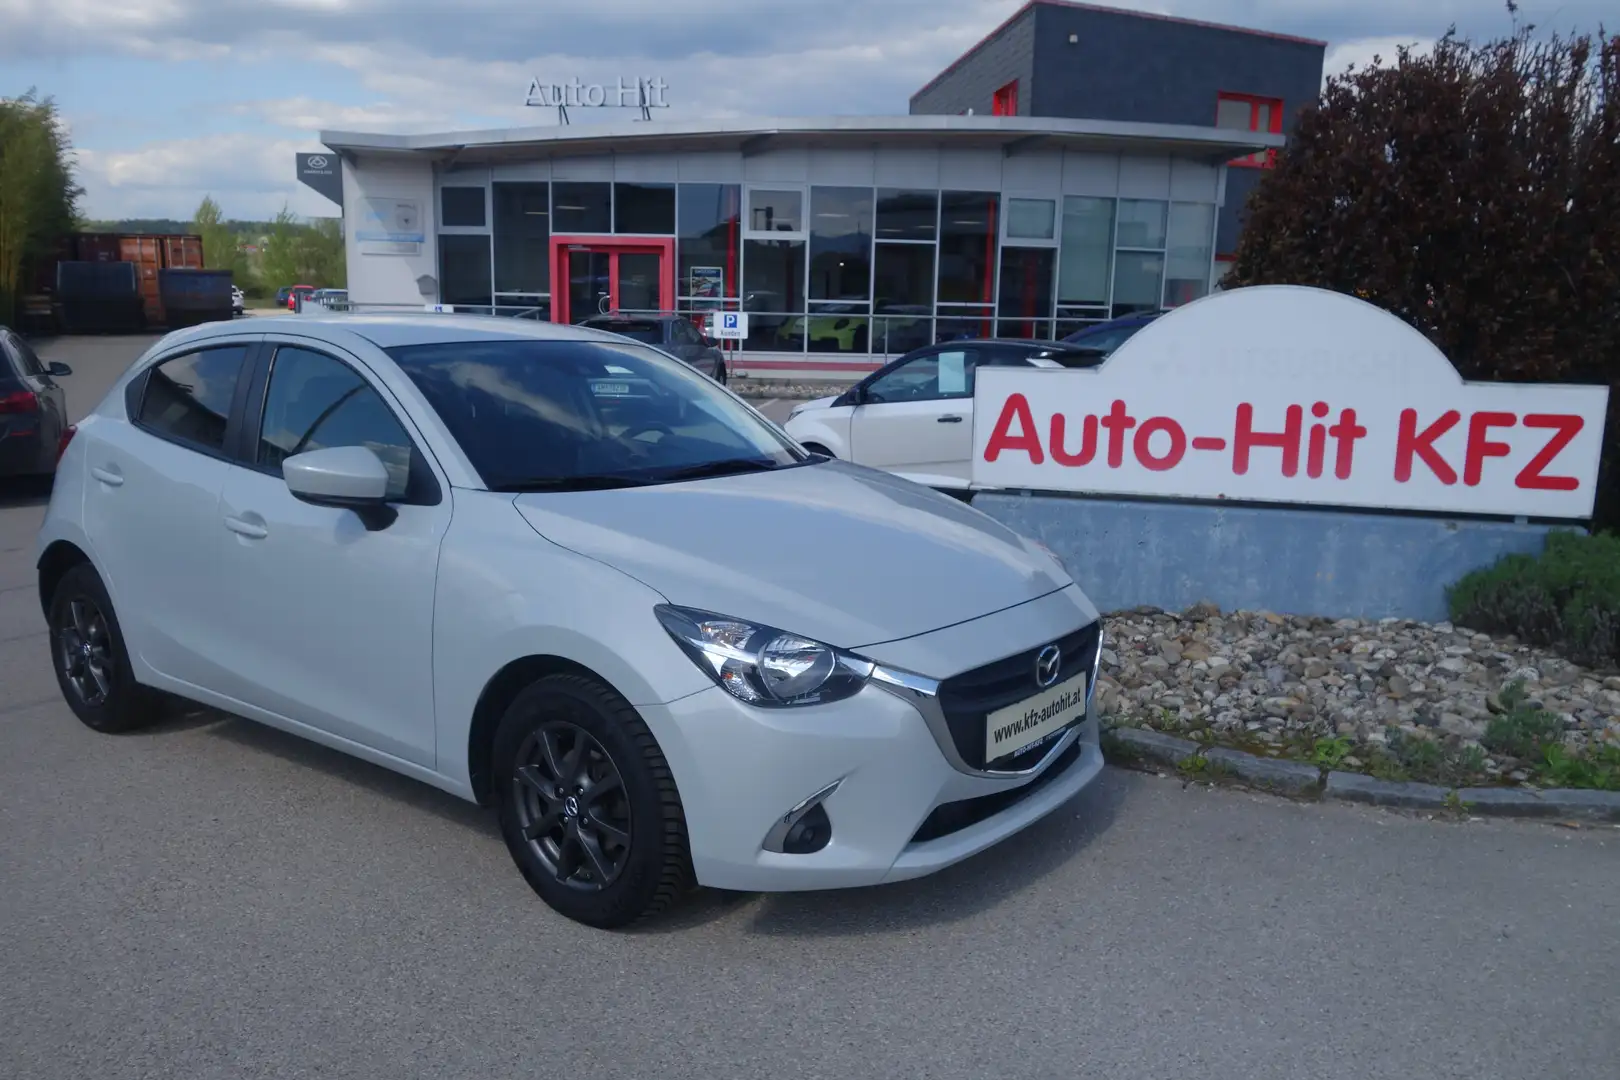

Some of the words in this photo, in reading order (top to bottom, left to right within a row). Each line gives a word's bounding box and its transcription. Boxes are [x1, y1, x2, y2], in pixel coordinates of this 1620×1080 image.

[525, 75, 606, 107] Auto
[617, 75, 670, 107] Hit
[726, 315, 735, 327] P
[983, 392, 1368, 480] Auto-Hit
[1393, 407, 1586, 491] KFZ
[994, 687, 1081, 744] www.kfz-autohit.at
